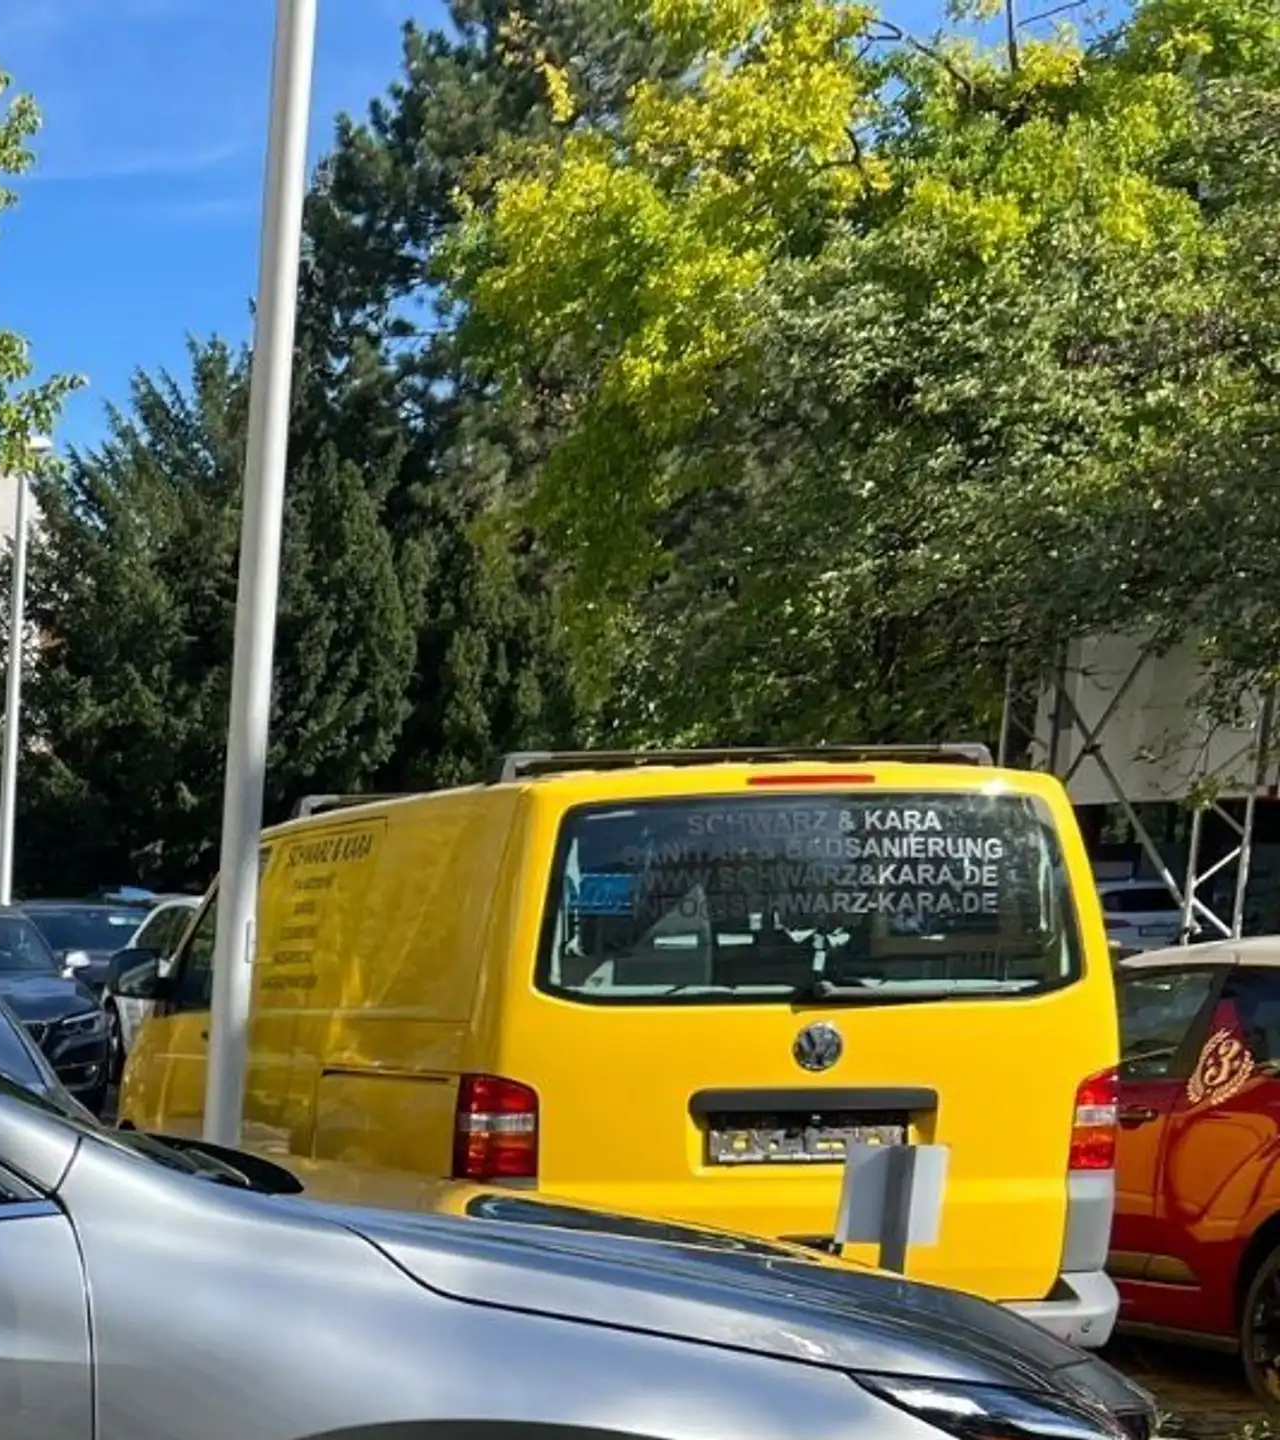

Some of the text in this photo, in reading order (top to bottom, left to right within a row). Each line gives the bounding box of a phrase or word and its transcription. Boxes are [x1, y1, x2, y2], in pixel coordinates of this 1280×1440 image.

[687, 809, 942, 836] SCHWARZ & KARA
